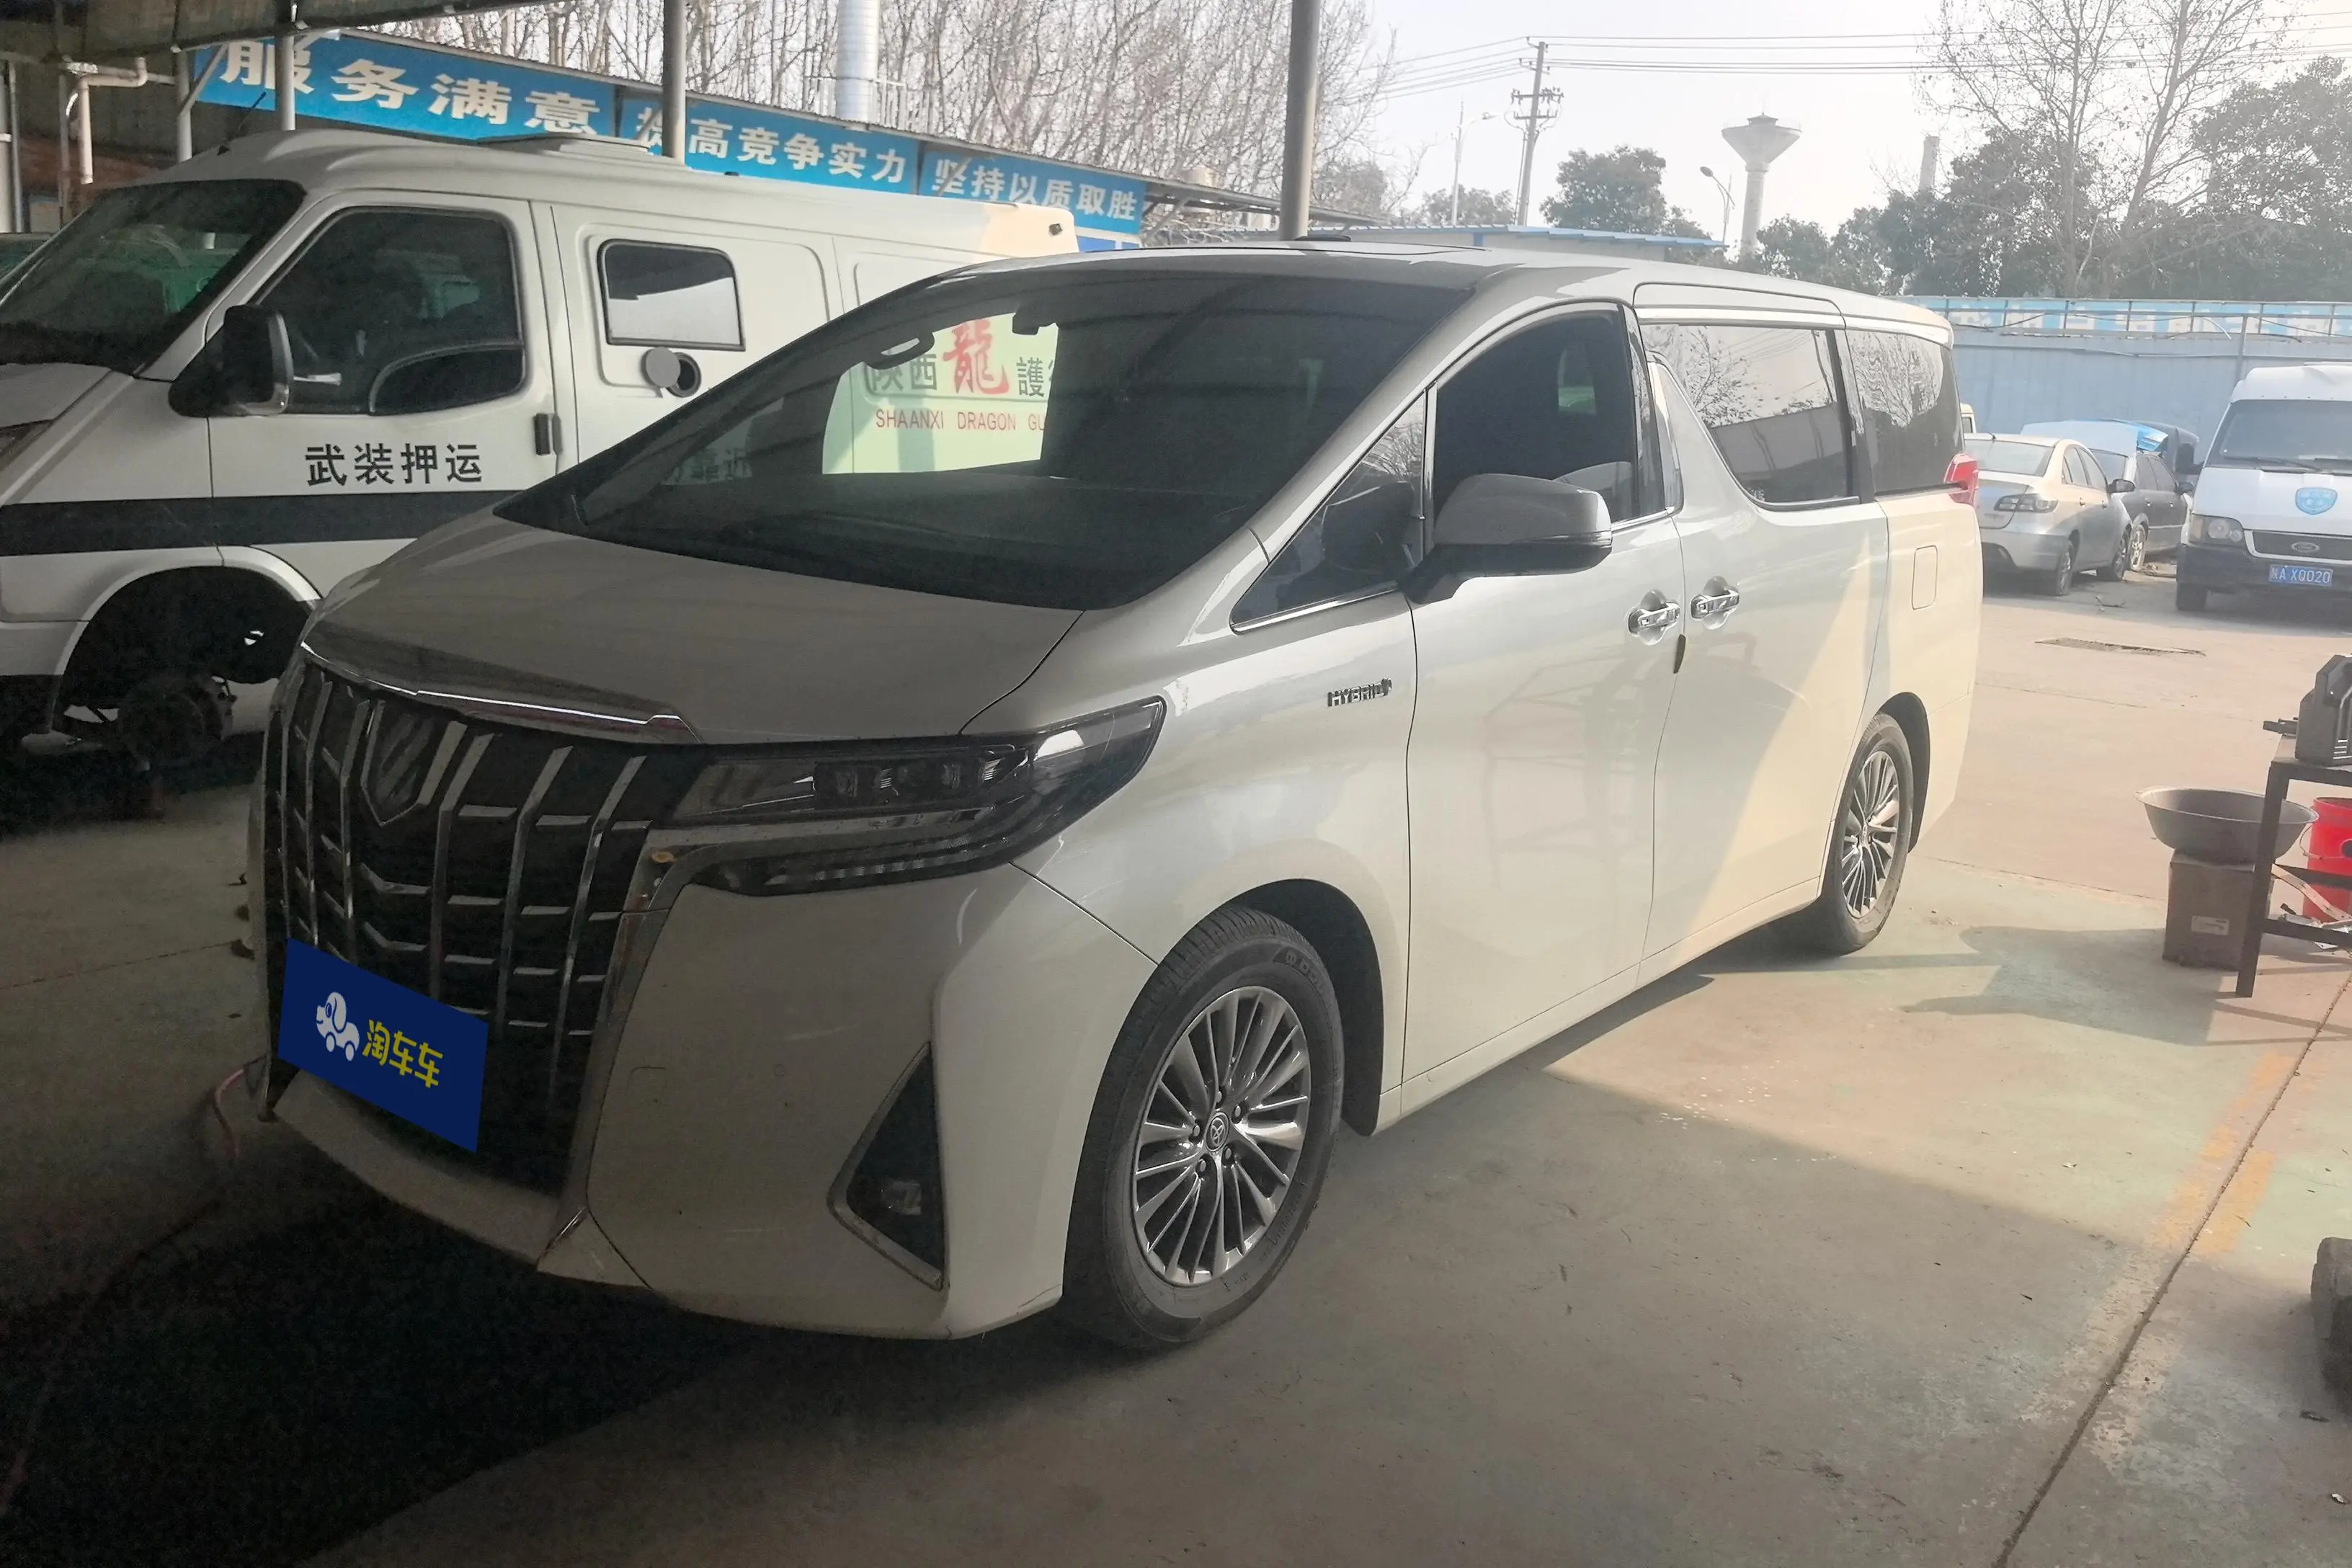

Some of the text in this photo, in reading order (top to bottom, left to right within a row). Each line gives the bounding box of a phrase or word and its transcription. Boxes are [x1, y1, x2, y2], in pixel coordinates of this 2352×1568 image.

[220, 41, 600, 135] 服务满意
[932, 159, 1138, 220] 坚持以质取胜
[871, 318, 1054, 397] 西龍護
[876, 409, 945, 429] SHAANXI
[957, 411, 1017, 431] DRAGON
[305, 442, 482, 486] 武装押运
[1327, 682, 1385, 707] HYBRID
